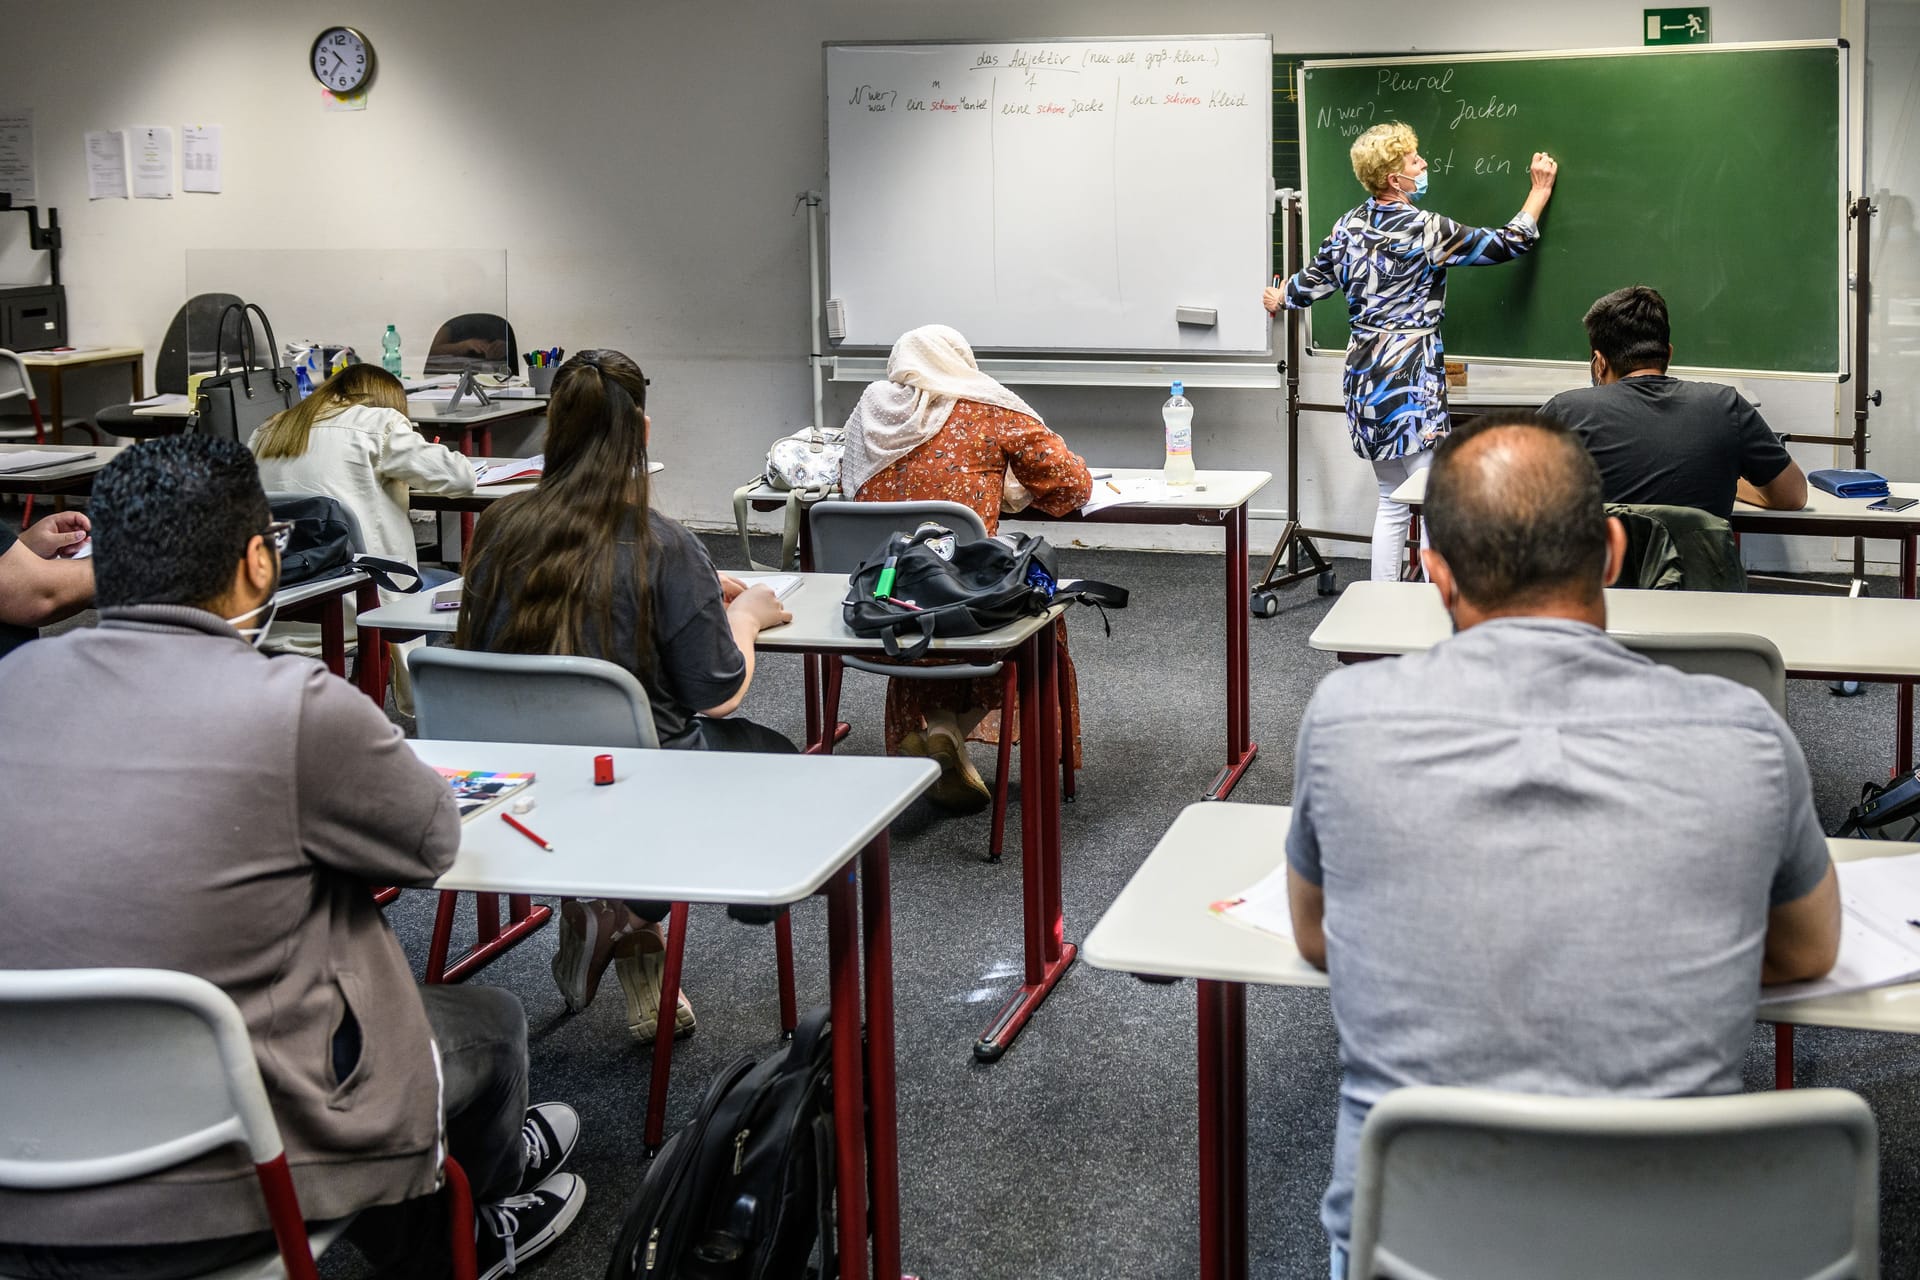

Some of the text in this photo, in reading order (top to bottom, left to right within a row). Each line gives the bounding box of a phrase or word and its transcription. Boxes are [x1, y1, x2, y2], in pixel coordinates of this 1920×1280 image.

[334, 34, 346, 46] 12
[319, 56, 327, 66] 9
[356, 54, 364, 64] 3
[976, 51, 999, 66] das
[1008, 48, 1071, 76] Adjektiv
[338, 76, 347, 86] 6
[932, 80, 941, 89] m
[1175, 75, 1189, 86] n
[1376, 68, 1453, 96] Plural
[906, 98, 926, 111] ein
[1129, 93, 1159, 106] ein
[1208, 89, 1249, 108] Kleid
[1000, 102, 1031, 116] eine
[1068, 98, 1105, 119] Jacke
[1449, 95, 1518, 130] Jacken
[1474, 154, 1510, 175] ein
